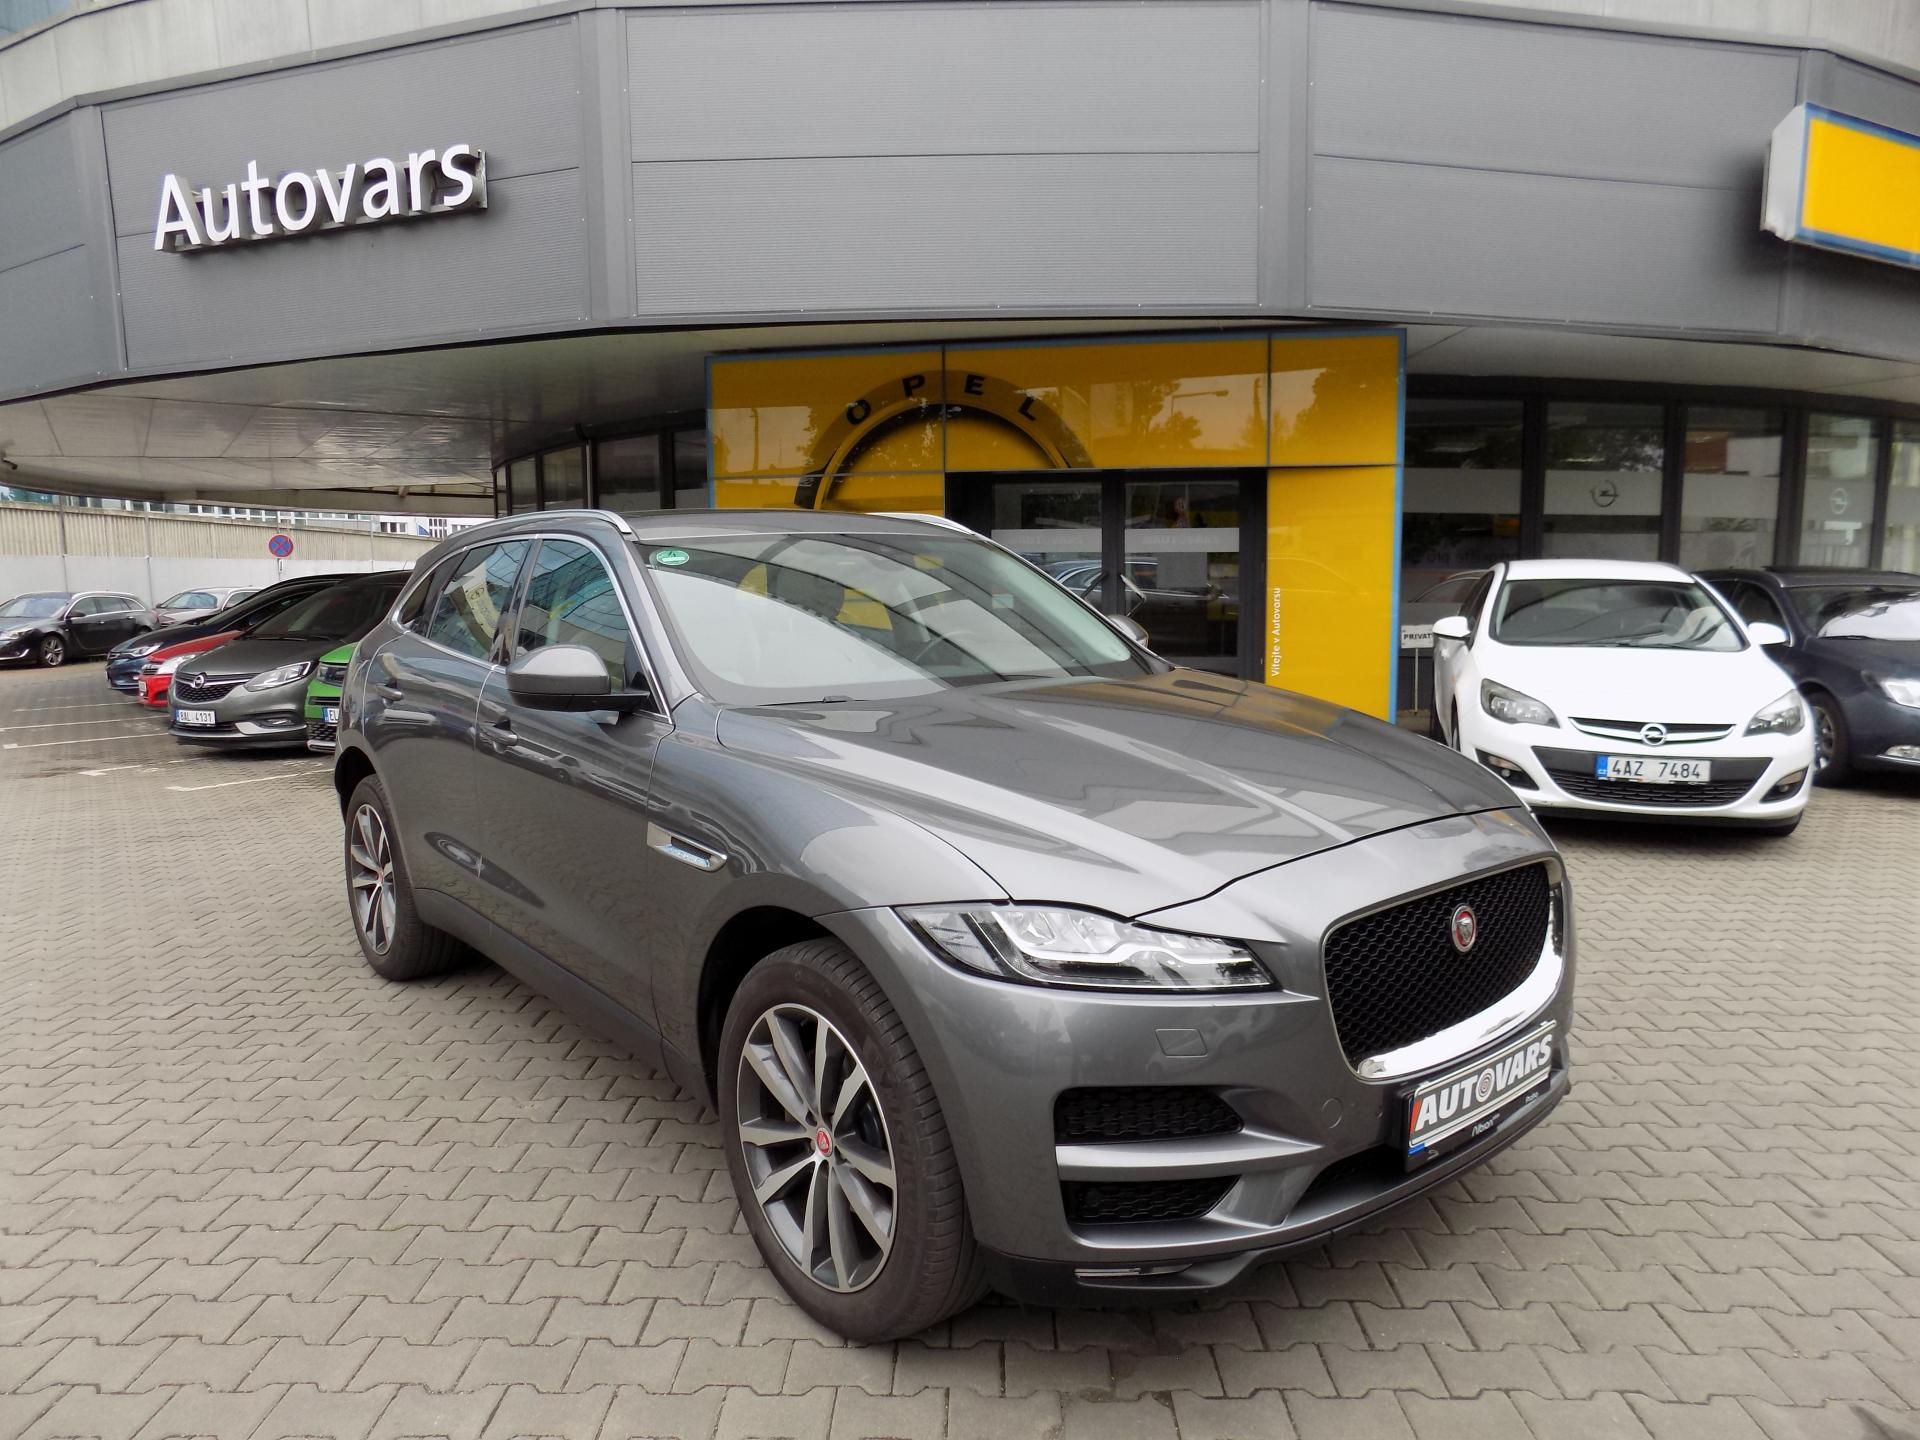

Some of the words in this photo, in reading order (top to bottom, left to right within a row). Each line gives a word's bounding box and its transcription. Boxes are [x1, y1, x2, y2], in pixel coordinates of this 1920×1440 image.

[154, 144, 476, 251] Autovars
[846, 374, 1038, 425] OPEL
[1271, 587, 1281, 636] Autovarsu
[1612, 760, 1644, 776] 4AZ
[1658, 762, 1701, 778] 7484
[1414, 1034, 1553, 1132] AUTOVARS
